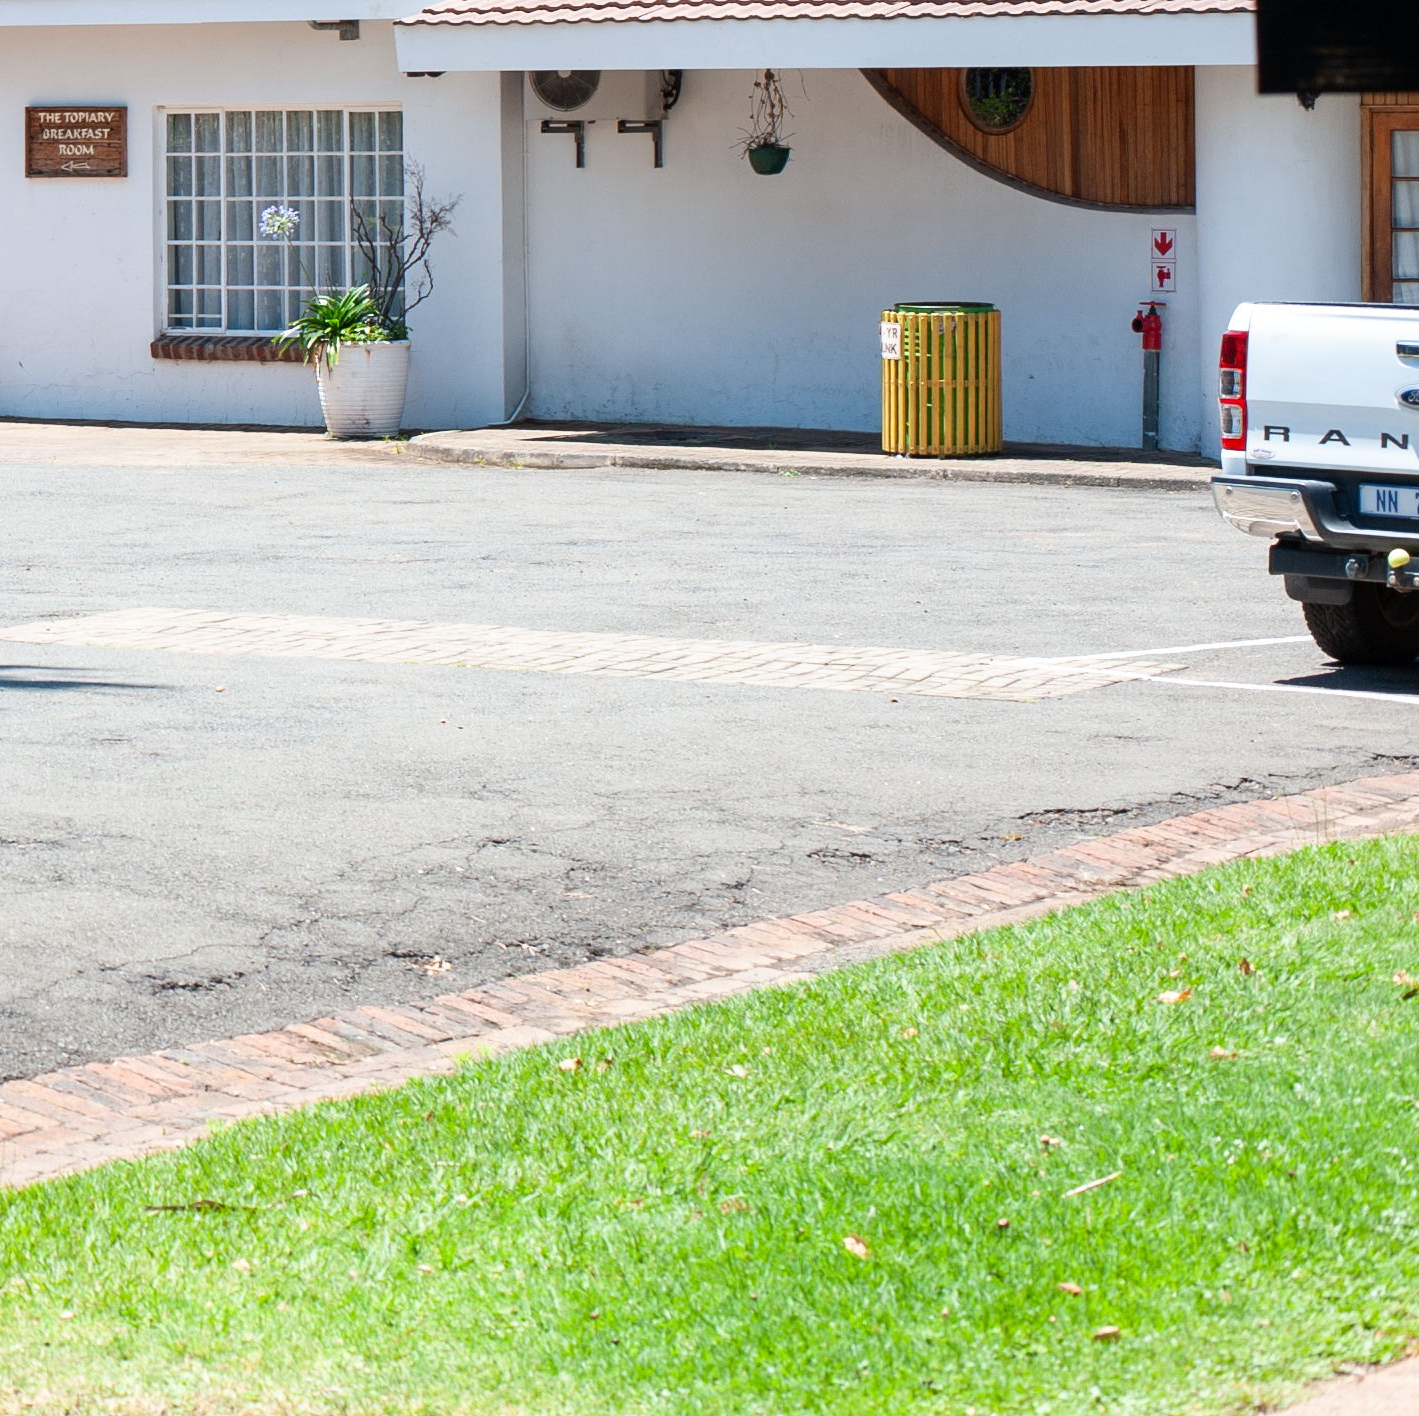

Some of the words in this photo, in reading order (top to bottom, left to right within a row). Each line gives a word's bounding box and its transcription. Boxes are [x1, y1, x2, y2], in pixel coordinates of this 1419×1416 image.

[38, 112, 62, 124] THE
[64, 111, 115, 123] TOPIARY
[43, 128, 111, 139] BREAKFAST
[58, 144, 94, 155] ROOM
[1263, 425, 1409, 450] RAN
[1376, 488, 1399, 514] NN
